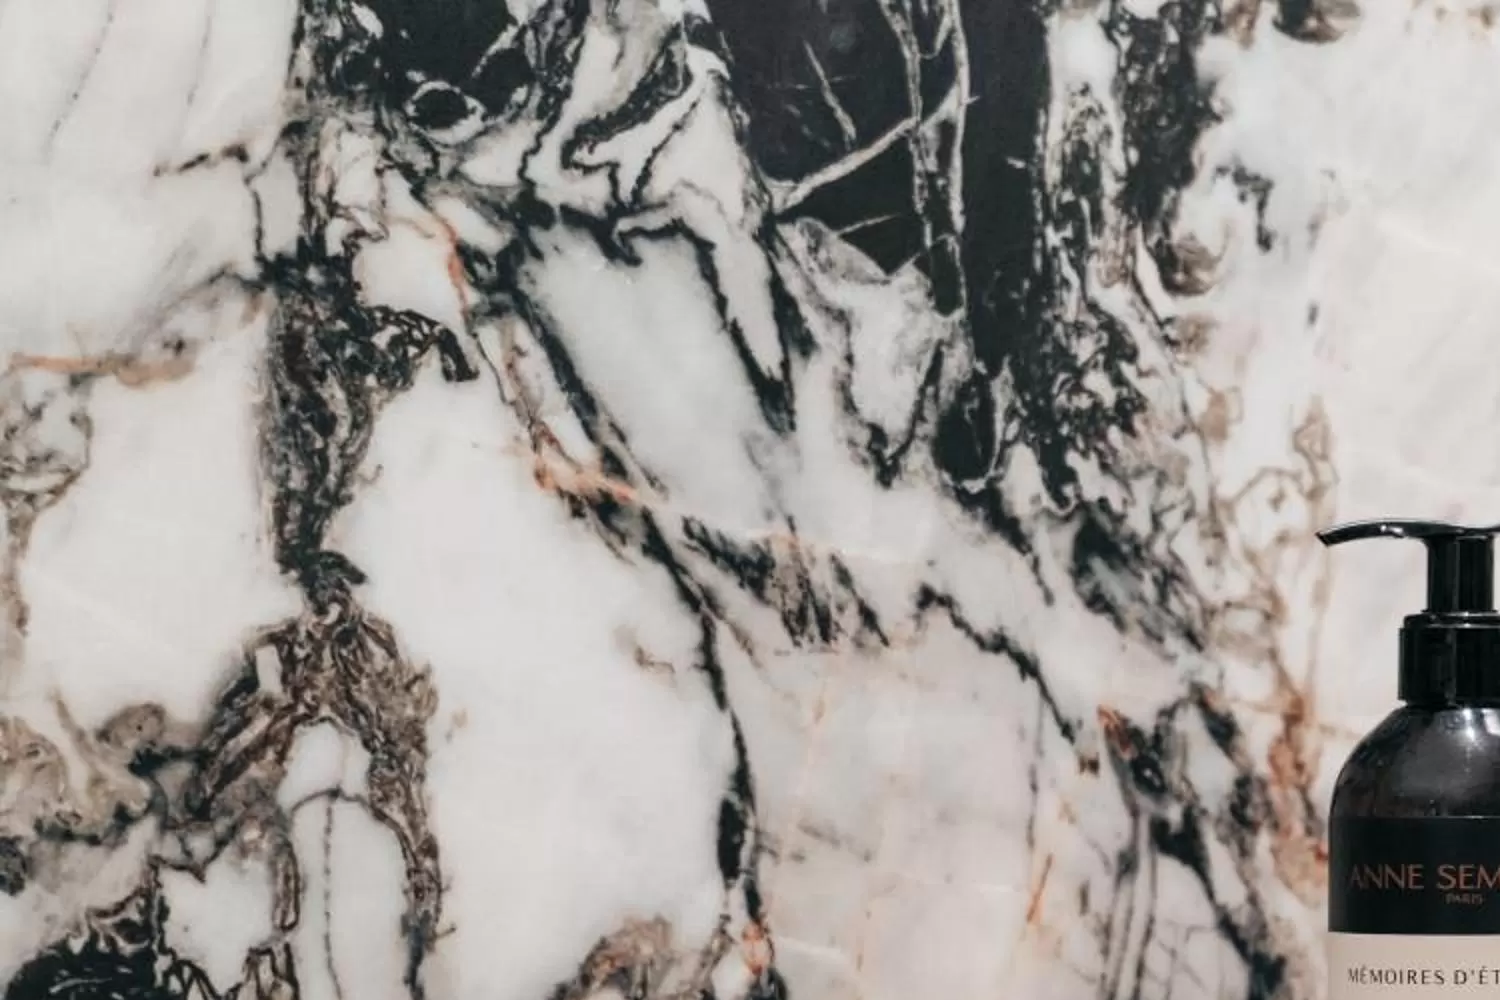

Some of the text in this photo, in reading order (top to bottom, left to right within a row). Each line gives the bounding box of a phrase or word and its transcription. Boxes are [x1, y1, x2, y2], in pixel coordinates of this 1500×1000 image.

[1351, 864, 1424, 890] ANNE
[1446, 893, 1483, 905] PARIS
[1347, 964, 1446, 985] MÉMOIRES
